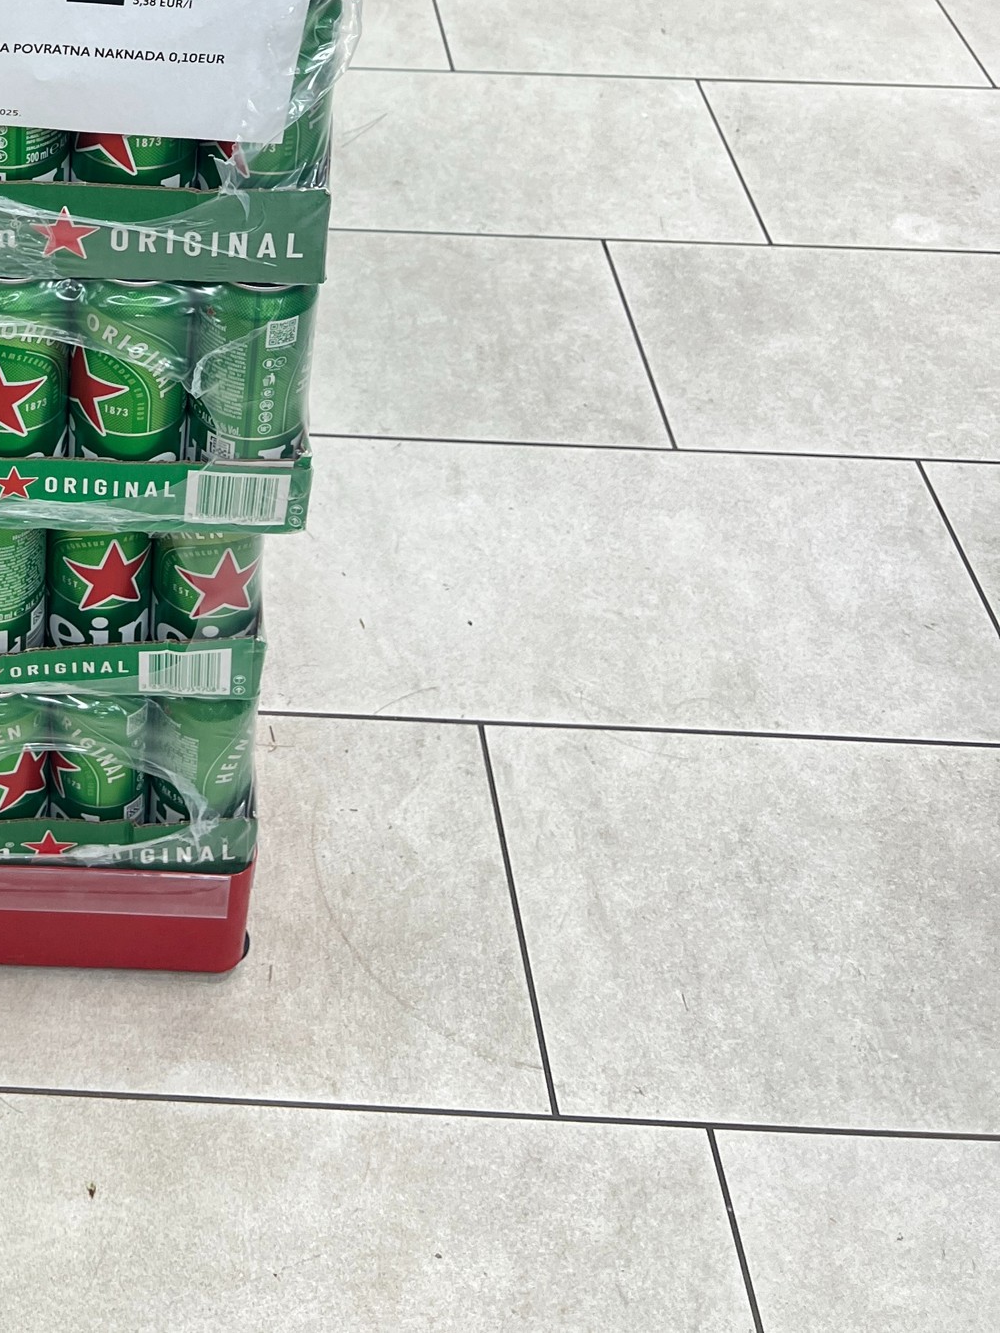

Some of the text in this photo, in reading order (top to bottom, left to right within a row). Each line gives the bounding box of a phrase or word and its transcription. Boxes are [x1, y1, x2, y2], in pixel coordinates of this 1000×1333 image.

[13, 43, 91, 58] POVRATNA
[94, 47, 165, 63] NAKNADA
[168, 52, 226, 65] 0,10EUR
[109, 226, 304, 259] ORIGINAL
[103, 404, 130, 418] 1873
[43, 475, 176, 499] ORIGINAL
[9, 659, 130, 679] ORIGINAL
